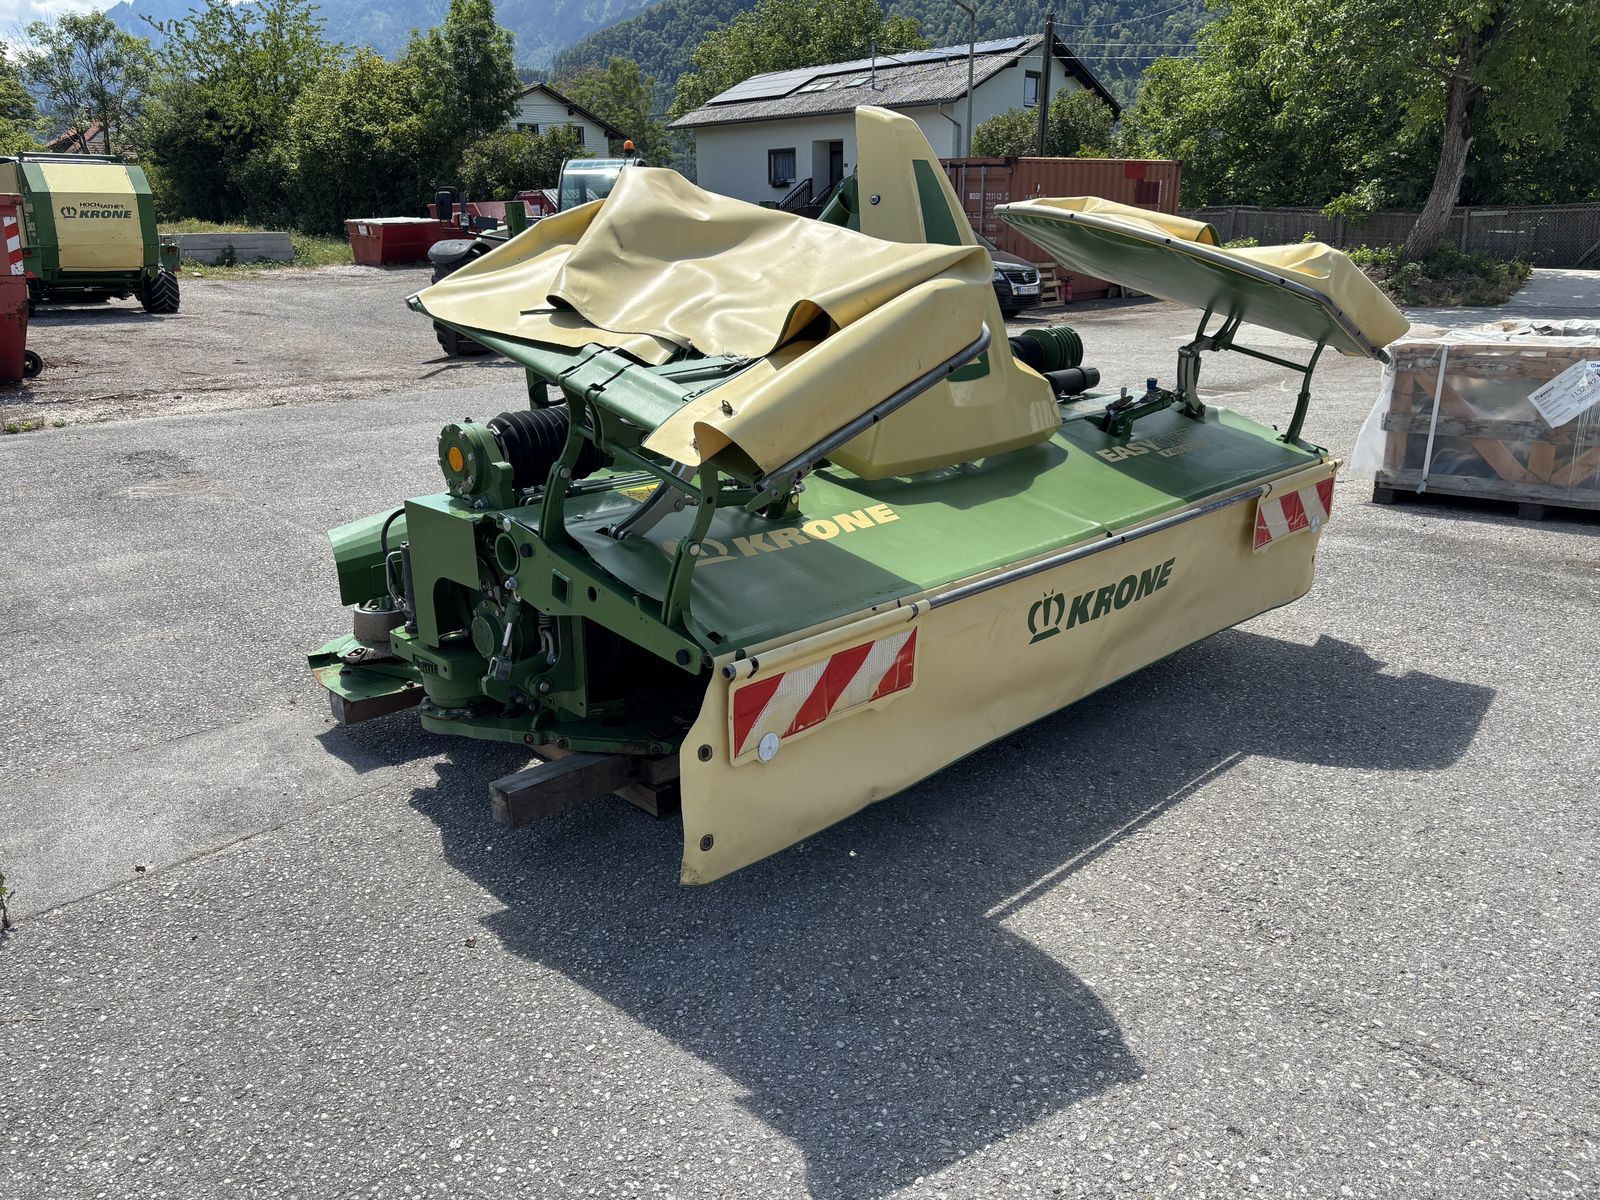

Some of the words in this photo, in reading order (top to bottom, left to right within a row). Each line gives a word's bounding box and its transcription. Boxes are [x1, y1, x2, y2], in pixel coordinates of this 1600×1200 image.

[79, 210, 132, 218] KRONE
[732, 503, 900, 557] KRONE
[1066, 557, 1176, 630] KRONE
